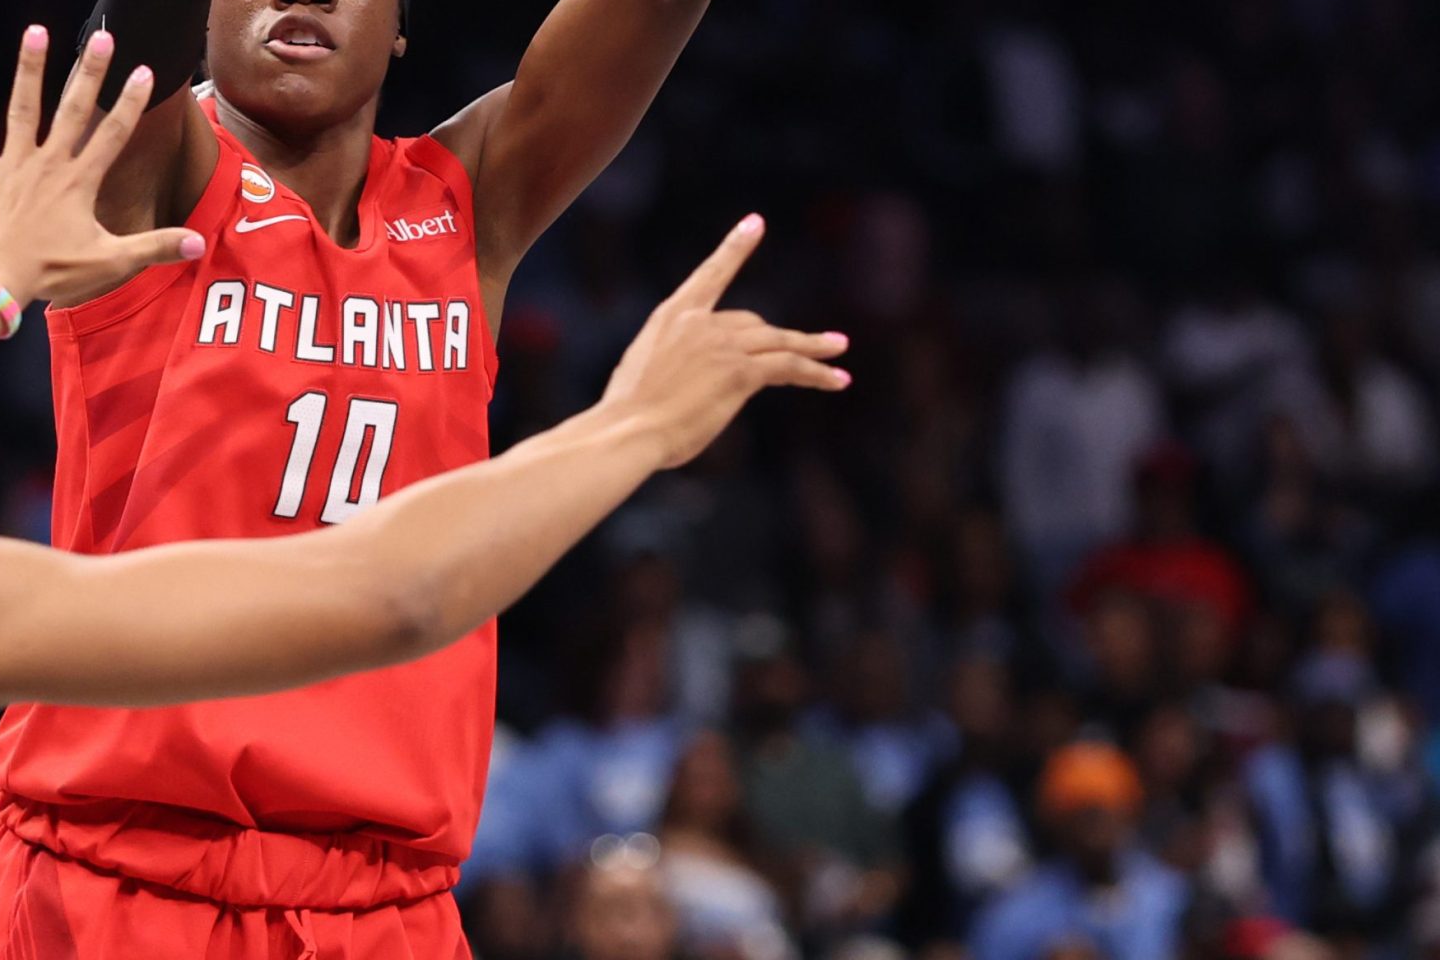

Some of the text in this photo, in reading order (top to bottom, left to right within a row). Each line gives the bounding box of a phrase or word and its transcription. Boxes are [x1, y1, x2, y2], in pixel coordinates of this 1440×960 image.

[384, 209, 457, 242] Albert
[196, 279, 470, 371] ATLANTA
[272, 390, 398, 525] 10
